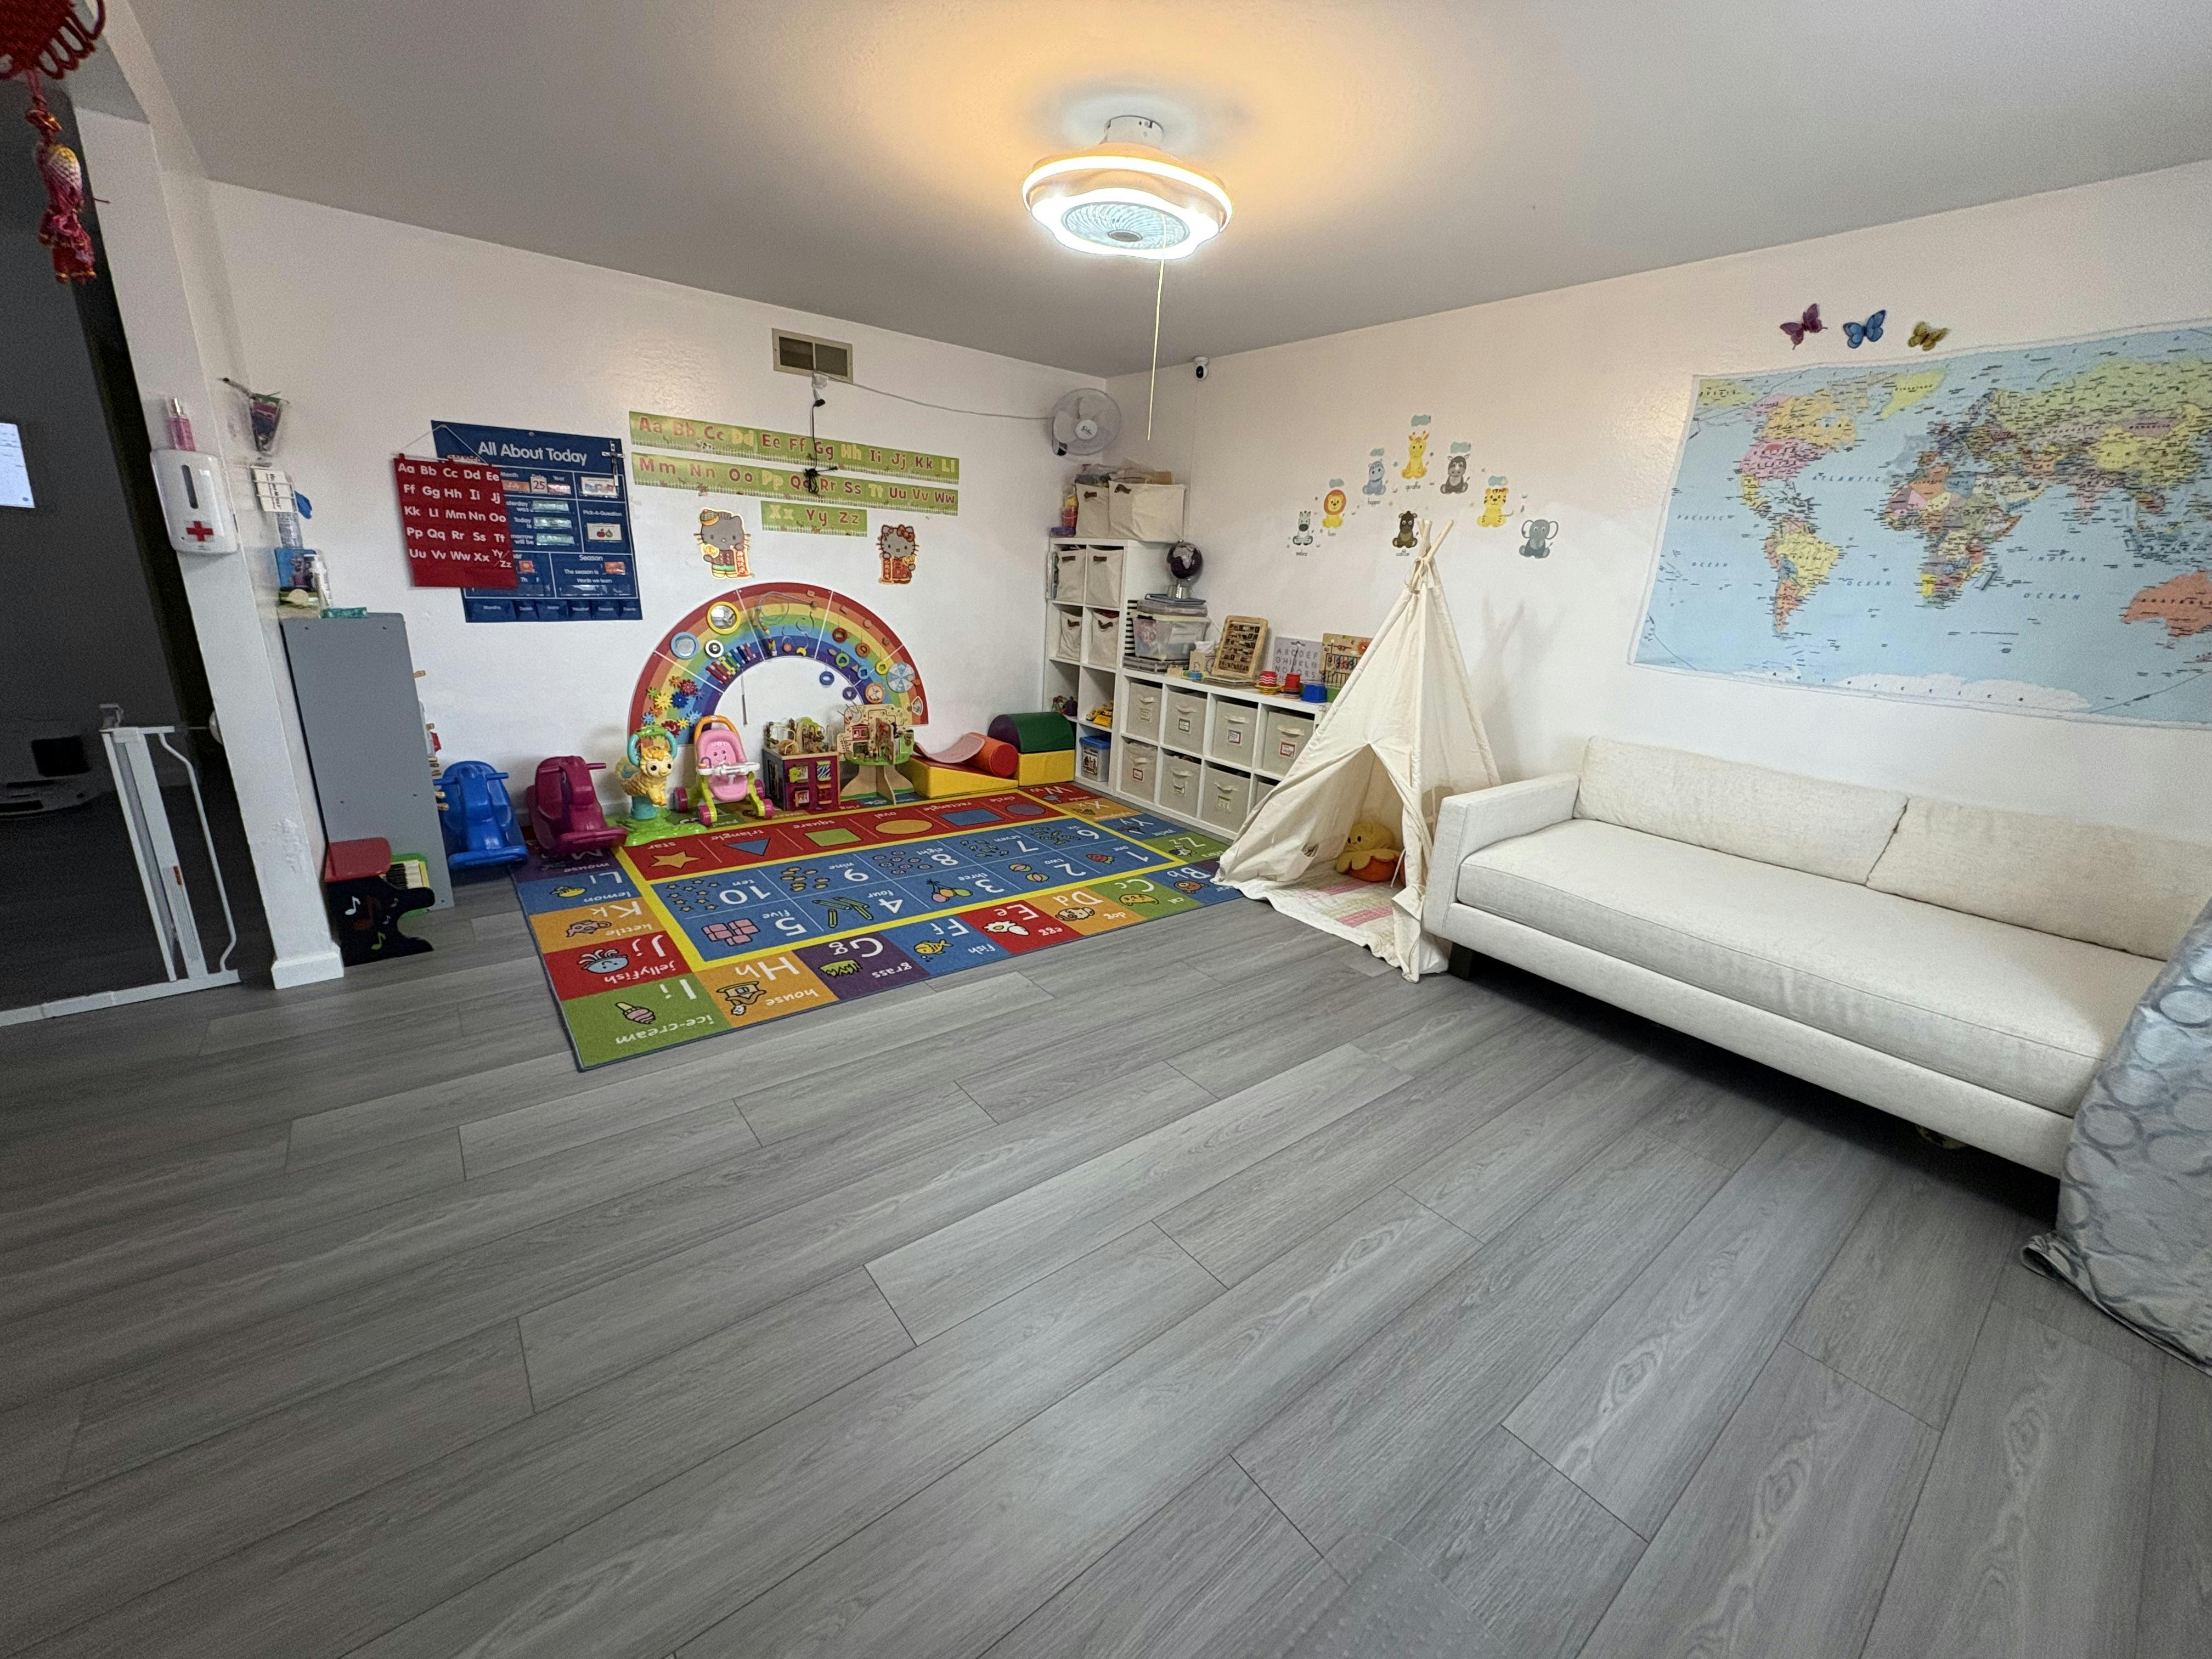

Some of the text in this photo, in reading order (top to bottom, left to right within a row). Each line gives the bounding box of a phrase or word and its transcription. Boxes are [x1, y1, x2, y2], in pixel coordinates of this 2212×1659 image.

[639, 417, 662, 434] Aa
[704, 425, 724, 441] Cc
[762, 434, 781, 448] Ee
[789, 437, 805, 452] Ff
[815, 441, 834, 460] Gg
[870, 449, 882, 462] Ii
[891, 453, 906, 470] Jj
[915, 456, 933, 469] Kk
[478, 441, 587, 466] All About Today
[398, 463, 500, 481] Aa Bb Cc Dd Ee
[533, 481, 545, 489] 25
[639, 457, 676, 475] Mm
[690, 463, 715, 478] Nn
[729, 467, 753, 483] Oo
[820, 478, 837, 492] Rr
[844, 481, 861, 495] Ss
[889, 487, 906, 499] Uu
[912, 488, 928, 501] Vv
[934, 491, 955, 504] Ww
[403, 484, 501, 504] Ff Gg Hh Ii Jj
[404, 506, 506, 523] Kk Ll Mm Nn Oo
[806, 509, 827, 526] Yy
[839, 511, 859, 524] Zz
[407, 527, 505, 543] Pp Qq Rr Ss Tt
[409, 549, 426, 558] Uu
[431, 550, 446, 560] Vv
[450, 551, 471, 561] Ww
[473, 552, 490, 562] Xx
[492, 549, 503, 558] Yy
[923, 800, 973, 812] rectangle
[793, 820, 835, 828] square
[711, 830, 764, 840] triangle
[994, 836, 1022, 844] seven
[1078, 829, 1102, 839] 6
[647, 841, 676, 849] star
[1017, 841, 1039, 852] 7
[932, 854, 958, 865] 8
[1127, 850, 1151, 862] 1
[564, 863, 610, 872] mouse
[830, 862, 854, 871] nine
[1054, 864, 1086, 876] 2
[1167, 867, 1212, 879] Bb
[590, 872, 622, 884] Ll
[844, 869, 868, 881] 9
[958, 873, 989, 882] three
[975, 879, 1004, 893] 3
[1115, 879, 1154, 892] Cc
[583, 890, 634, 902] lemon
[720, 886, 770, 904] 10
[868, 890, 894, 899] four
[1053, 891, 1103, 906] Dd
[590, 901, 641, 917] Kk
[879, 899, 902, 913] 4
[994, 904, 1039, 921] Ee
[763, 910, 791, 919] five
[606, 923, 652, 936] kettle
[775, 917, 806, 936] 5
[931, 919, 969, 936] Ff
[1039, 927, 1062, 935] egg
[632, 935, 665, 957] Jj
[829, 938, 883, 957] Gg
[968, 944, 995, 954] fish
[604, 959, 675, 984] jellyfish
[736, 957, 799, 980] Hh
[872, 962, 912, 978] grass
[766, 989, 819, 1006] house
[616, 1014, 714, 1046] ice-cream
